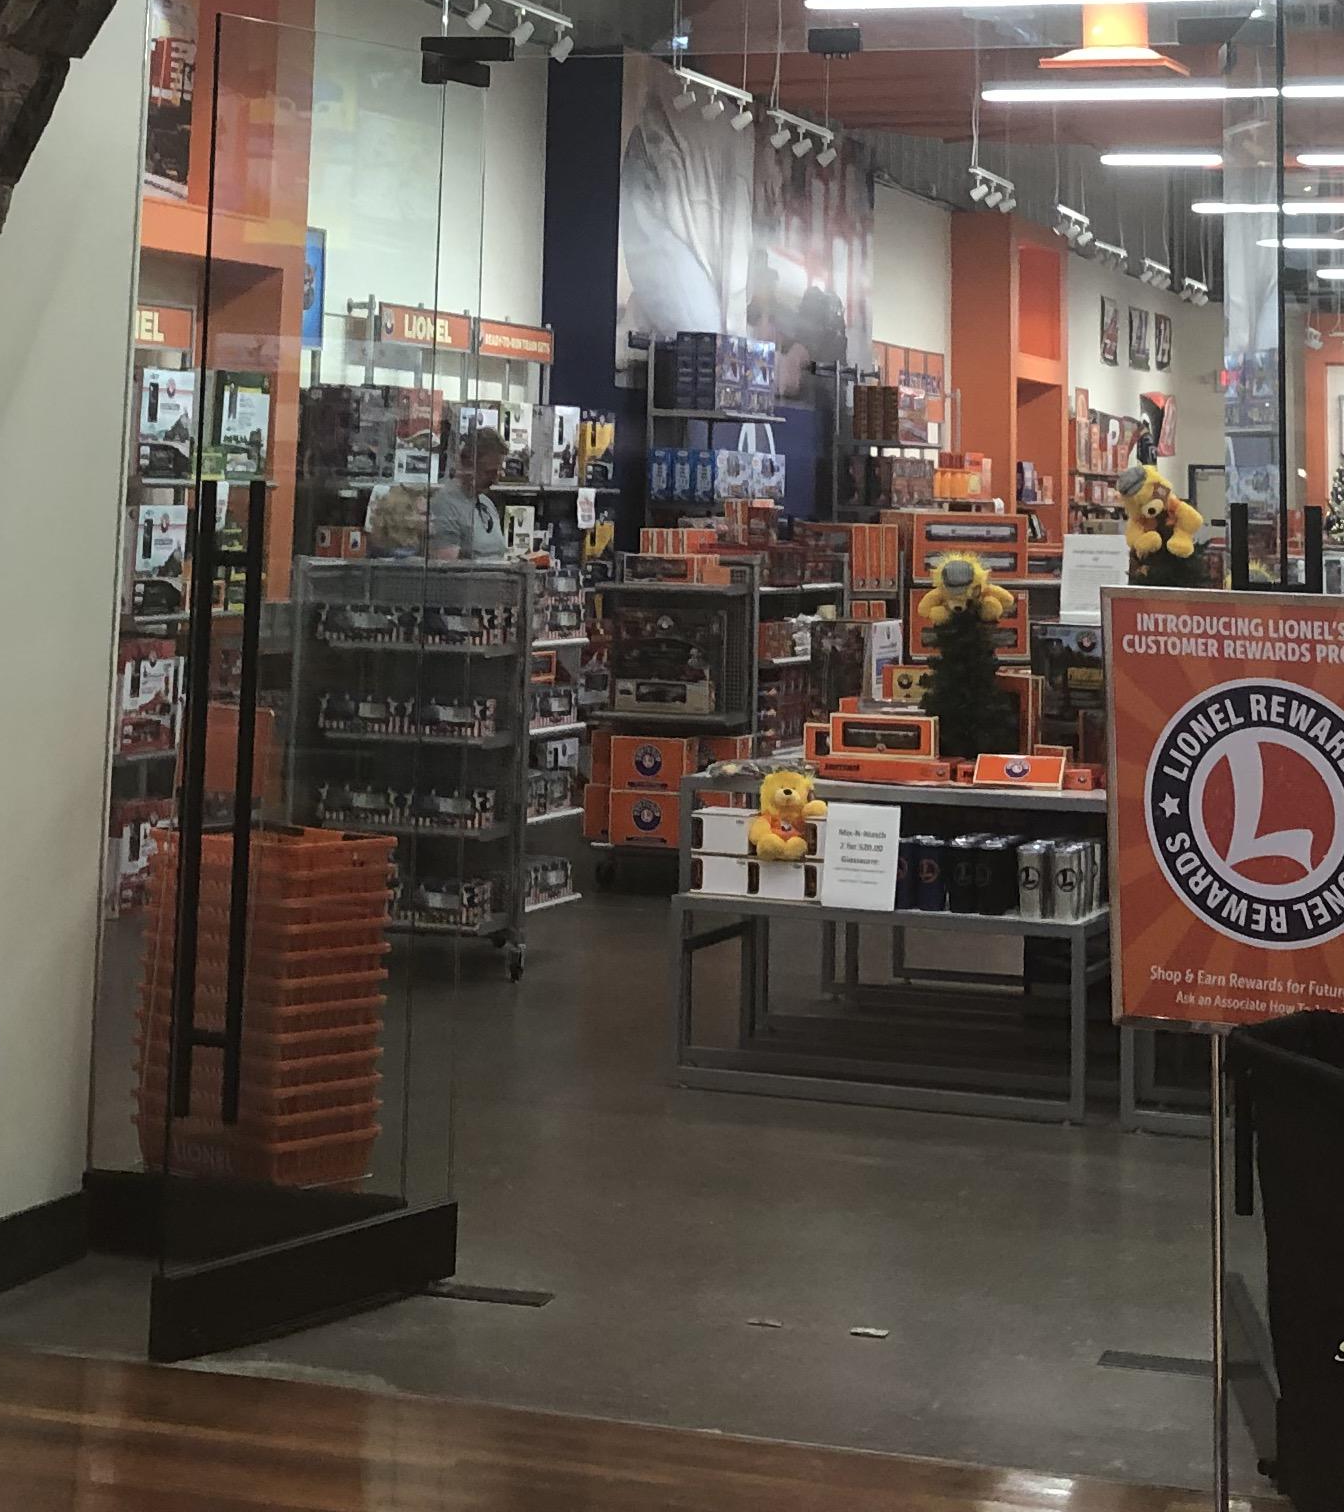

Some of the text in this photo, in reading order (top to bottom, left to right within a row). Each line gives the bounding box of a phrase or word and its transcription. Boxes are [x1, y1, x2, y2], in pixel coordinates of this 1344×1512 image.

[404, 314, 453, 345] LIONEL
[1136, 613, 1264, 637] INTRODUCING
[1122, 634, 1219, 658] CUSTOMER
[1223, 639, 1311, 663] REWARDS
[1163, 699, 1244, 782] LIONEL
[1165, 832, 1288, 934] REWARDS
[1150, 965, 1182, 986] Shop
[1185, 969, 1194, 984] &
[1197, 970, 1226, 987] Earn
[1229, 973, 1283, 993] Rewards
[1286, 979, 1306, 994] for
[1176, 990, 1195, 1005] Ask
[1197, 995, 1211, 1007] an
[1214, 994, 1267, 1013] Associate
[1269, 999, 1295, 1015] How
